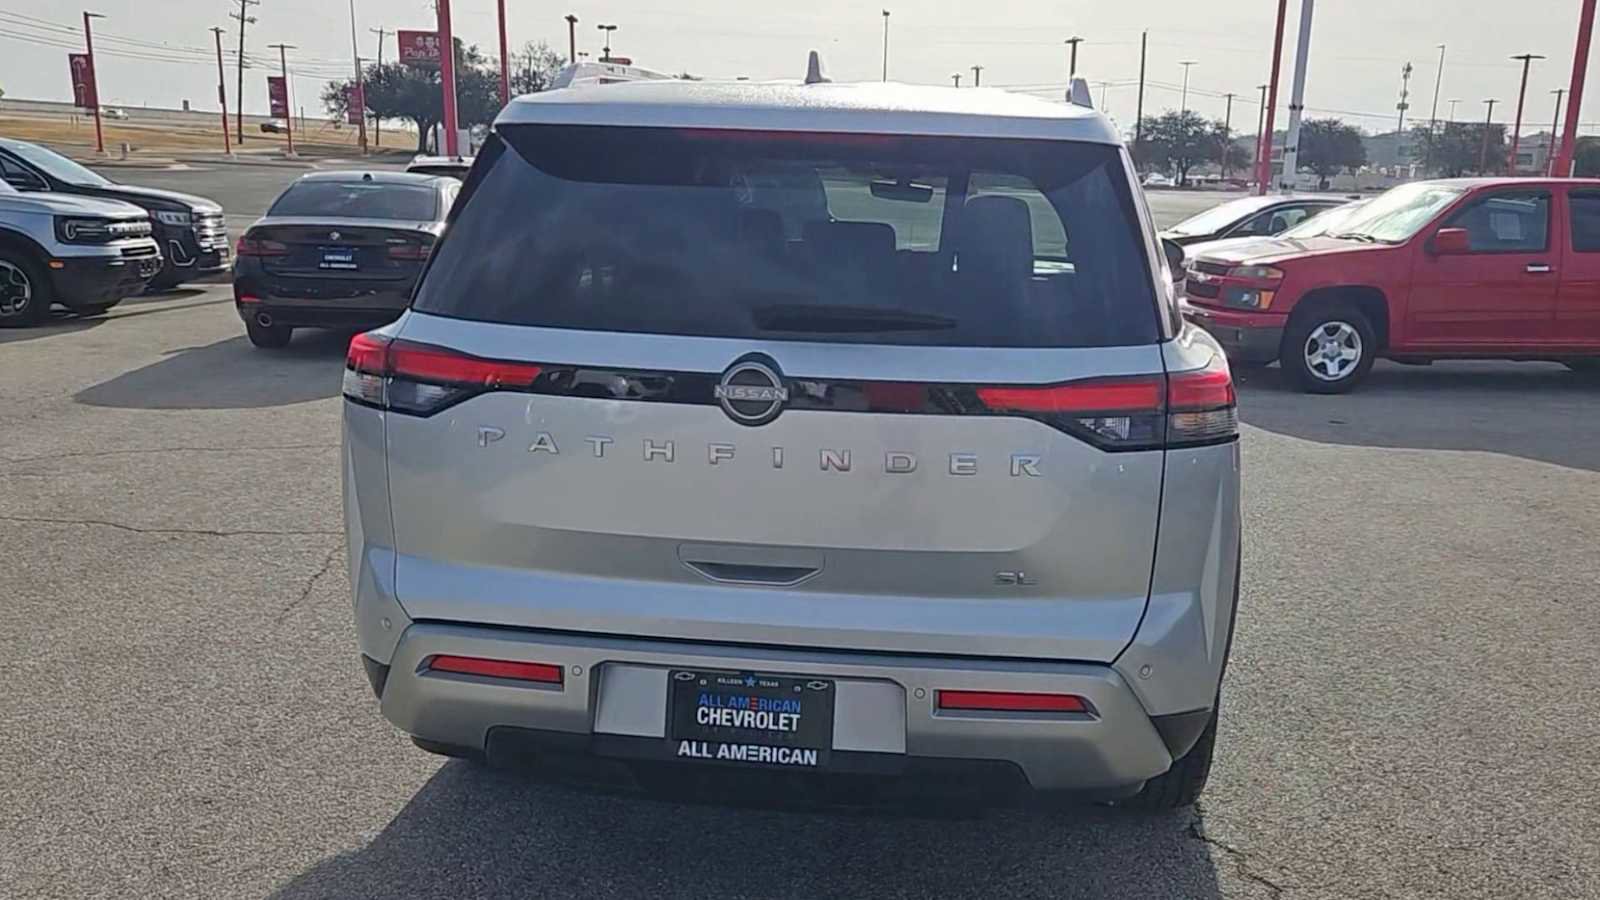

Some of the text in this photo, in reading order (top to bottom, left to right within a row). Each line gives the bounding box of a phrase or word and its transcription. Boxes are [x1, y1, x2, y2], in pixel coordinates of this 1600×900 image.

[714, 384, 789, 401] NISSAN
[478, 425, 1043, 477] PATHFINDER
[995, 571, 1038, 586] SL
[698, 693, 801, 713] ALL AMERICAN
[697, 706, 801, 731] CHEVROLET
[677, 739, 818, 766] ALL AMERICAN
